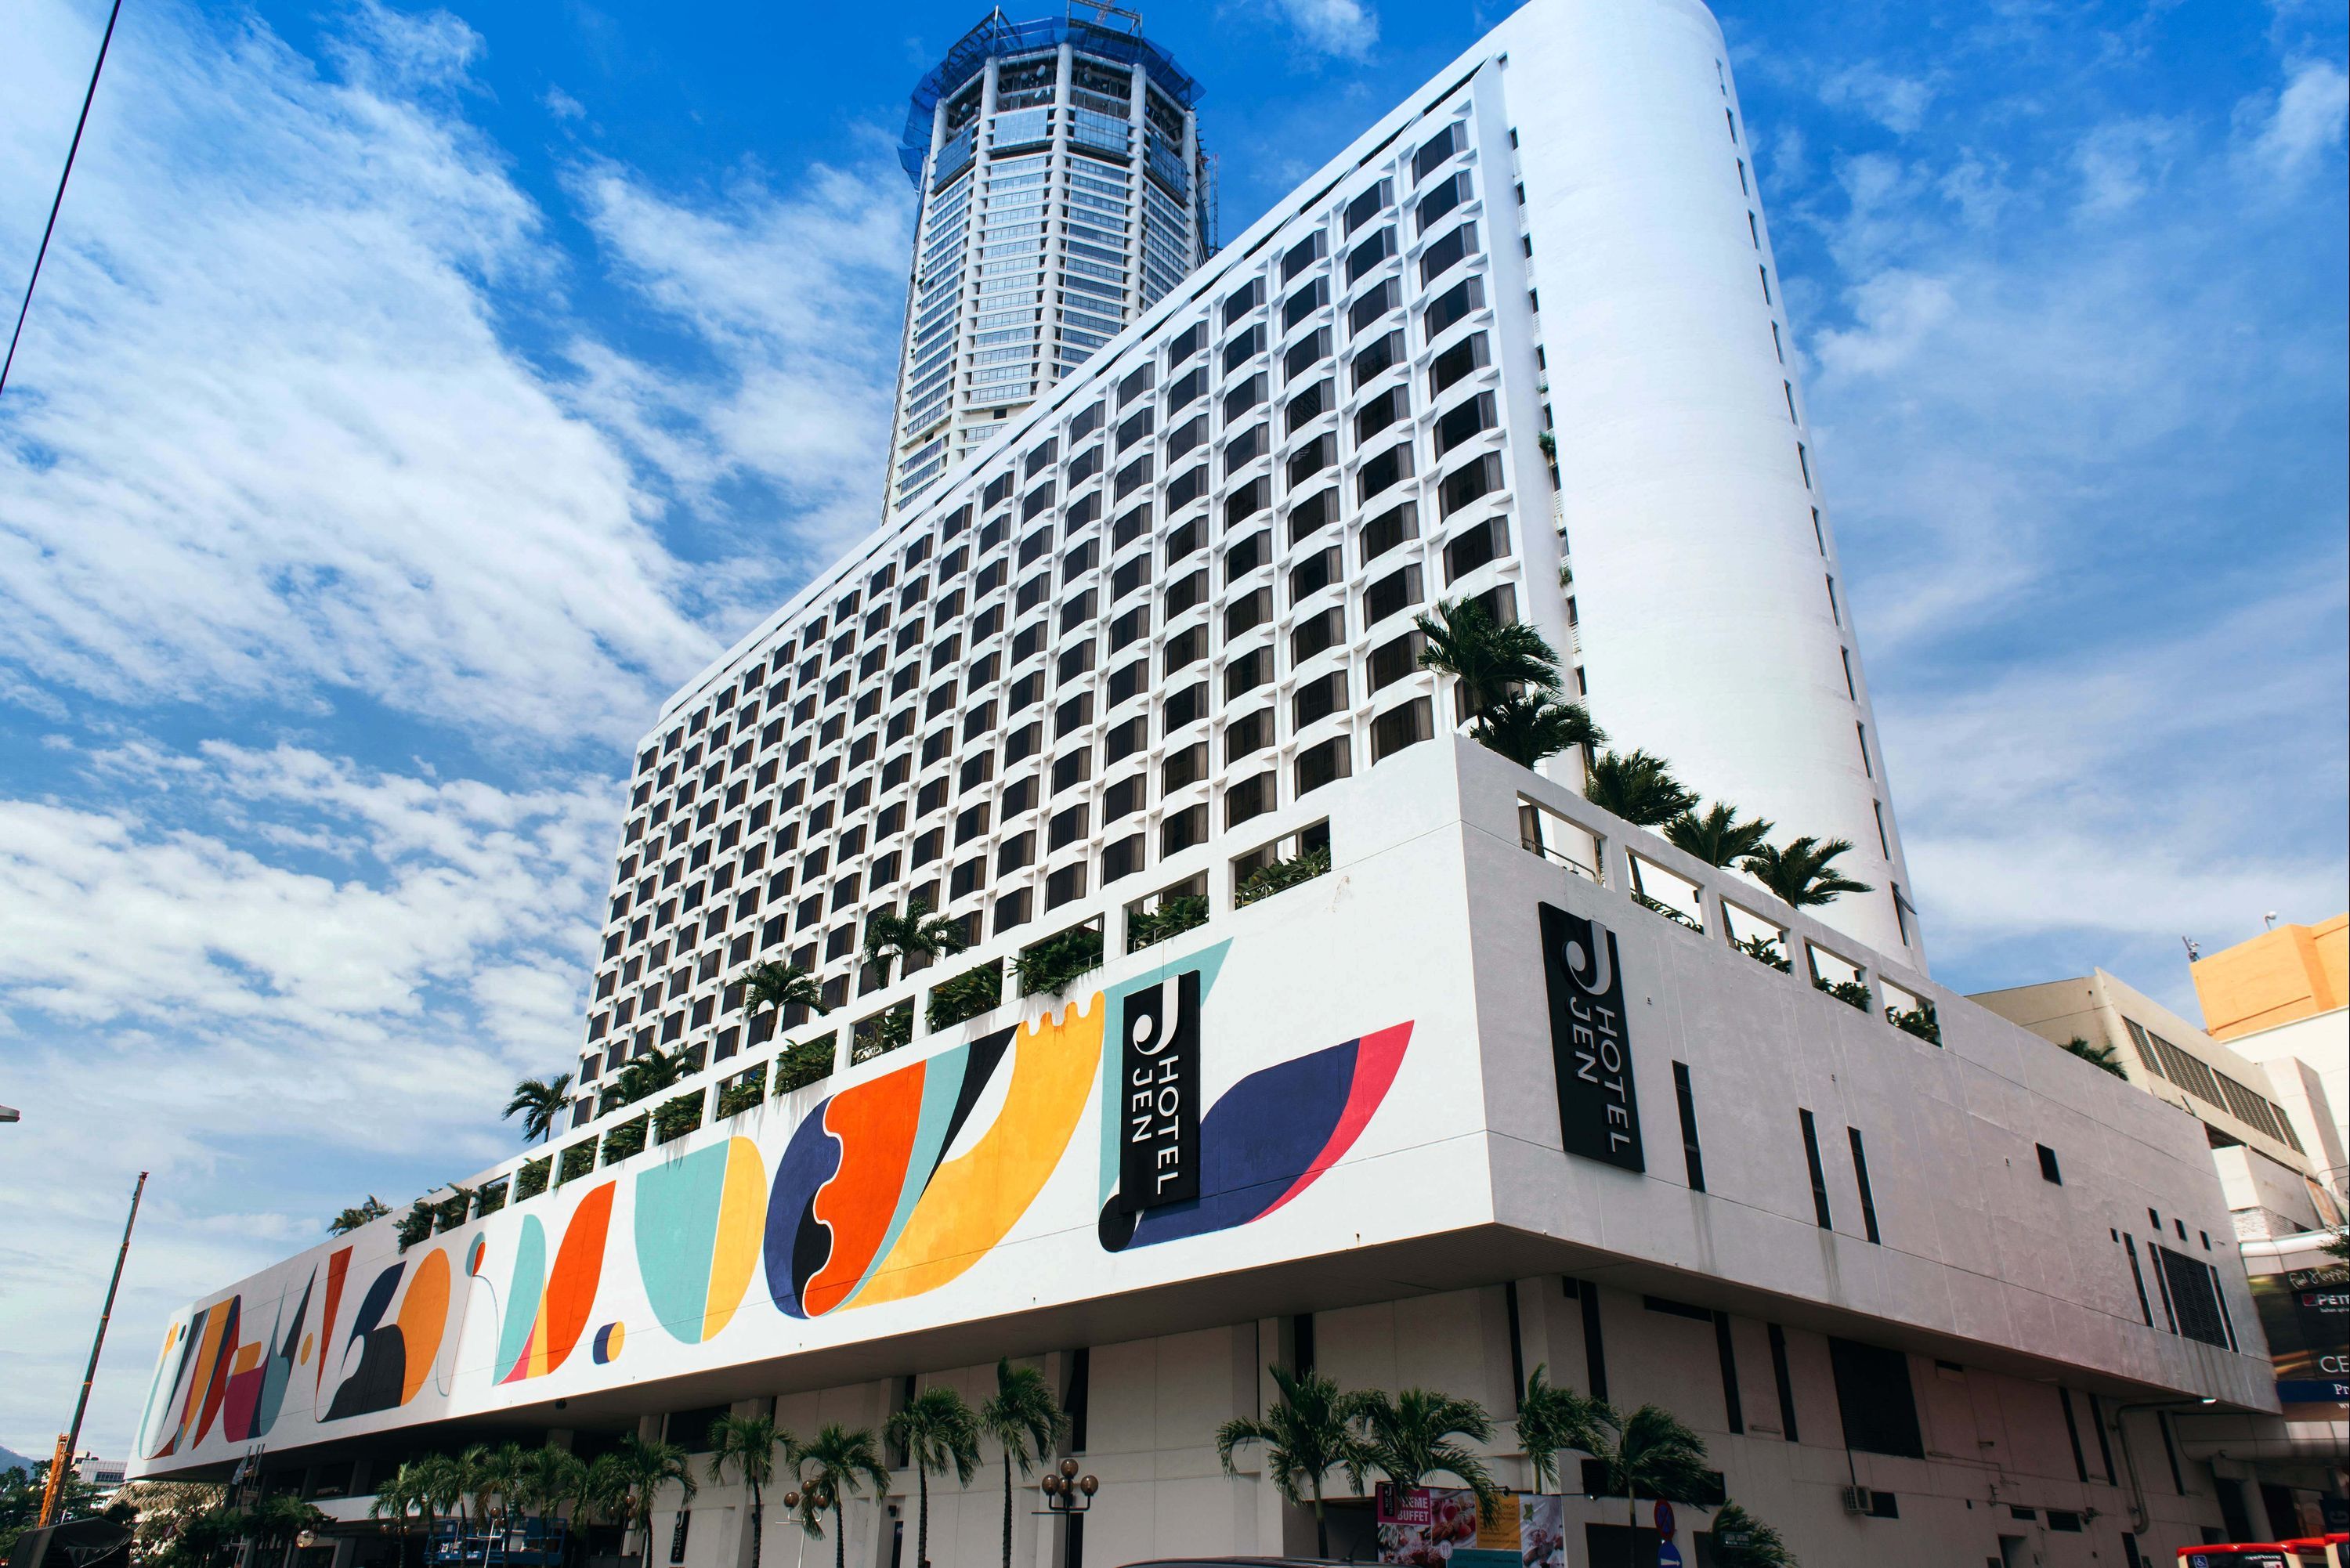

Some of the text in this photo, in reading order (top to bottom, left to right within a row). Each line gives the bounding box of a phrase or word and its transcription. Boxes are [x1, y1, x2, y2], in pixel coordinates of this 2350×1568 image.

[1566, 919, 1611, 995] J
[1133, 974, 1180, 1055] J
[1570, 996, 1598, 1083] JEN
[1132, 1068, 1153, 1143] JEN
[1596, 1006, 1630, 1152] HOTEL
[1157, 1055, 1180, 1194] HOTEL
[1397, 1509, 1429, 1522] BUFFET
